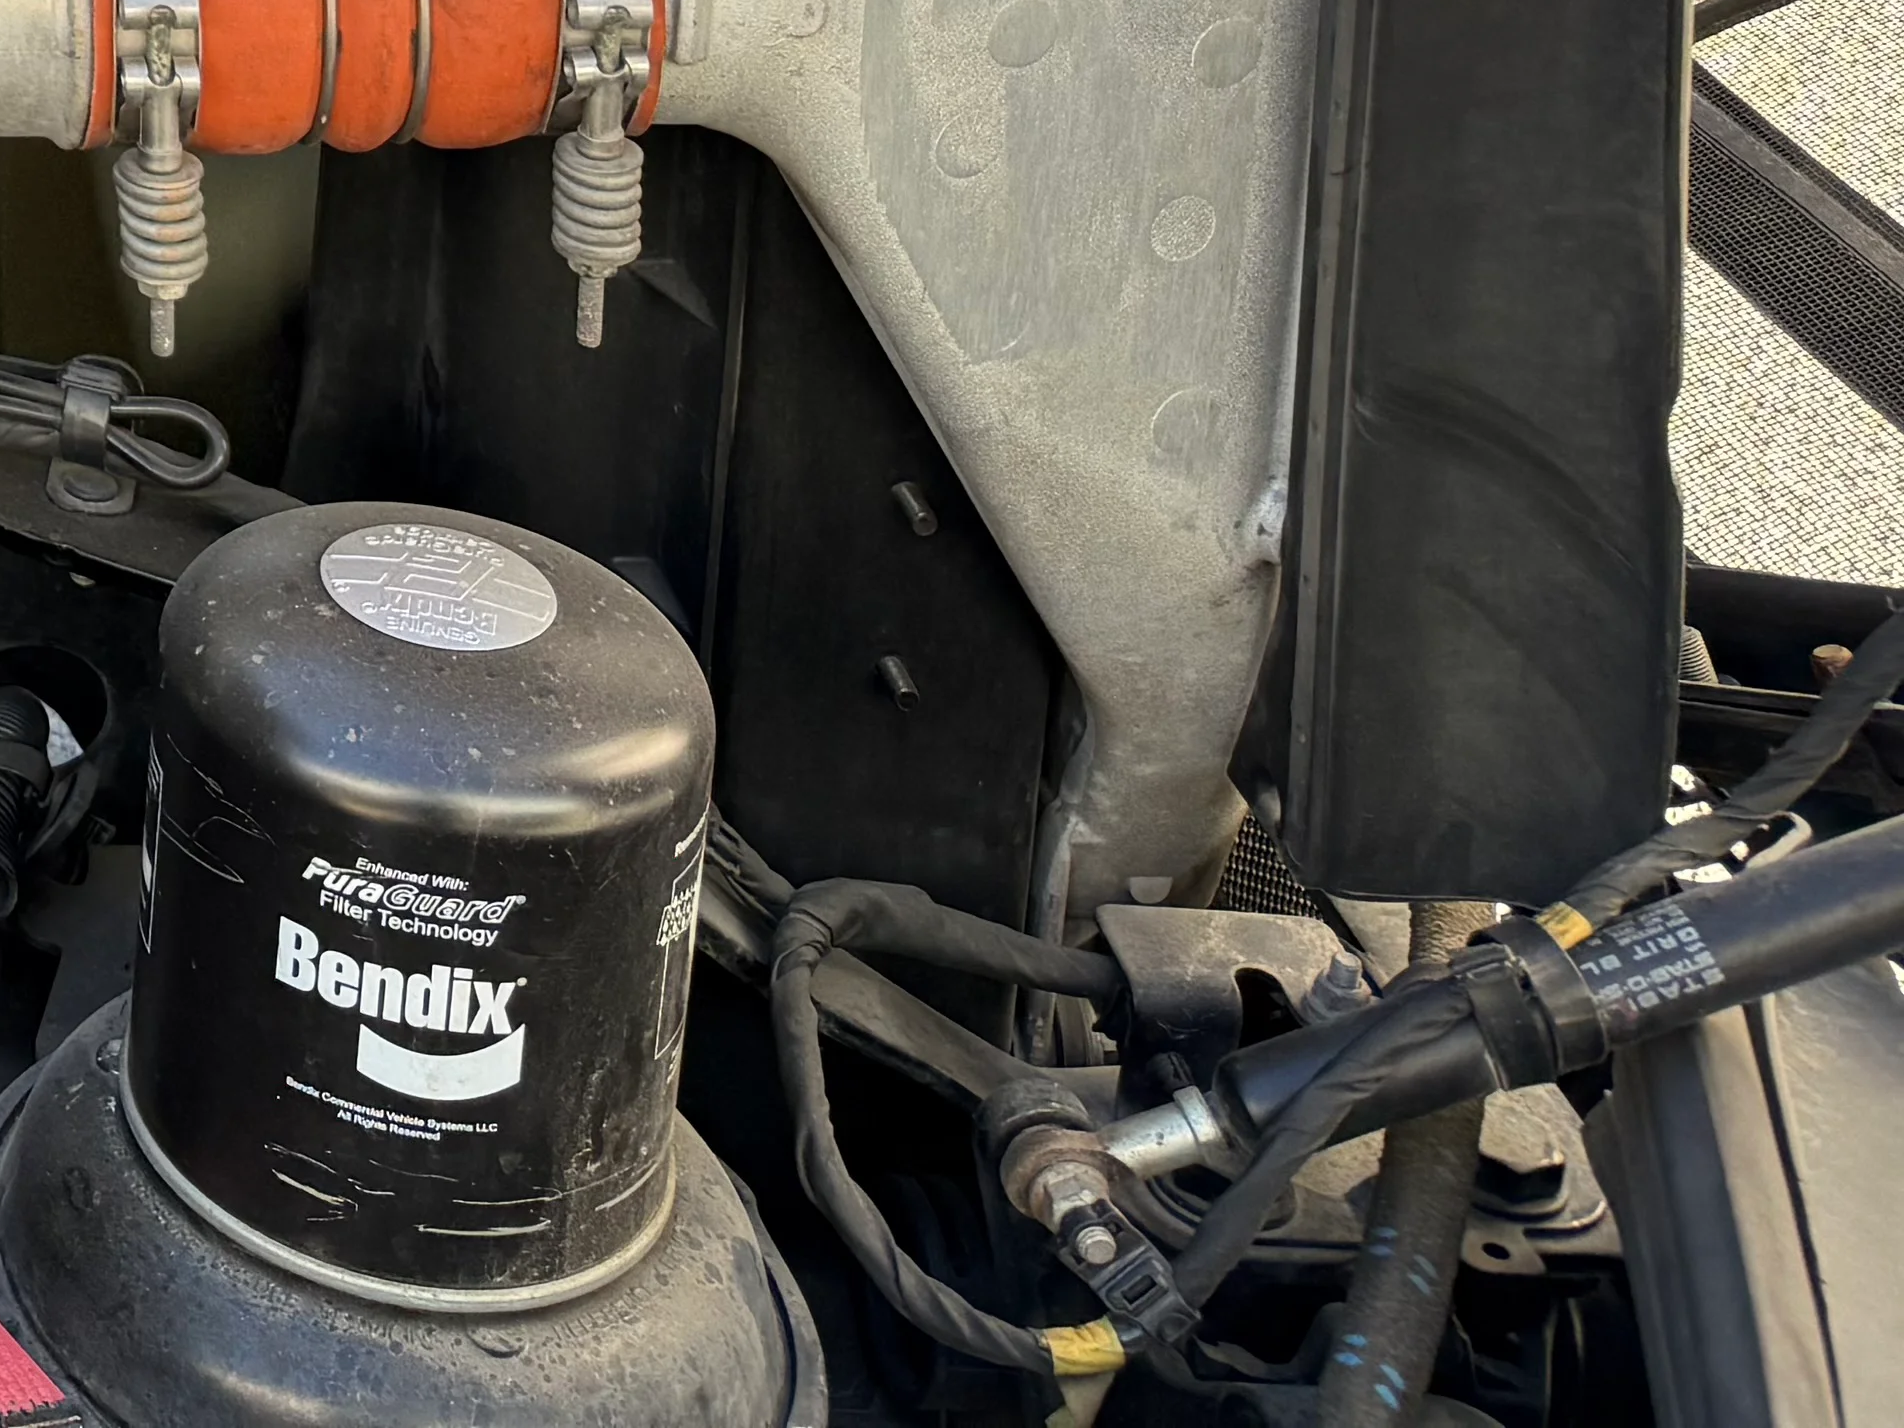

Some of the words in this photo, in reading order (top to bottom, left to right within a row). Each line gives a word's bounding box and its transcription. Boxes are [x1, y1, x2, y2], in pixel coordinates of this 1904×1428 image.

[302, 857, 518, 924] PuraGuard
[355, 857, 429, 886] Enhanced
[432, 874, 470, 892] With:
[319, 889, 373, 923] Filter
[377, 908, 499, 947] Technology
[275, 916, 517, 1035] Bendix
[321, 1092, 385, 1119] Commercial
[386, 1111, 425, 1127] Vehicle
[475, 1122, 499, 1133] LLC
